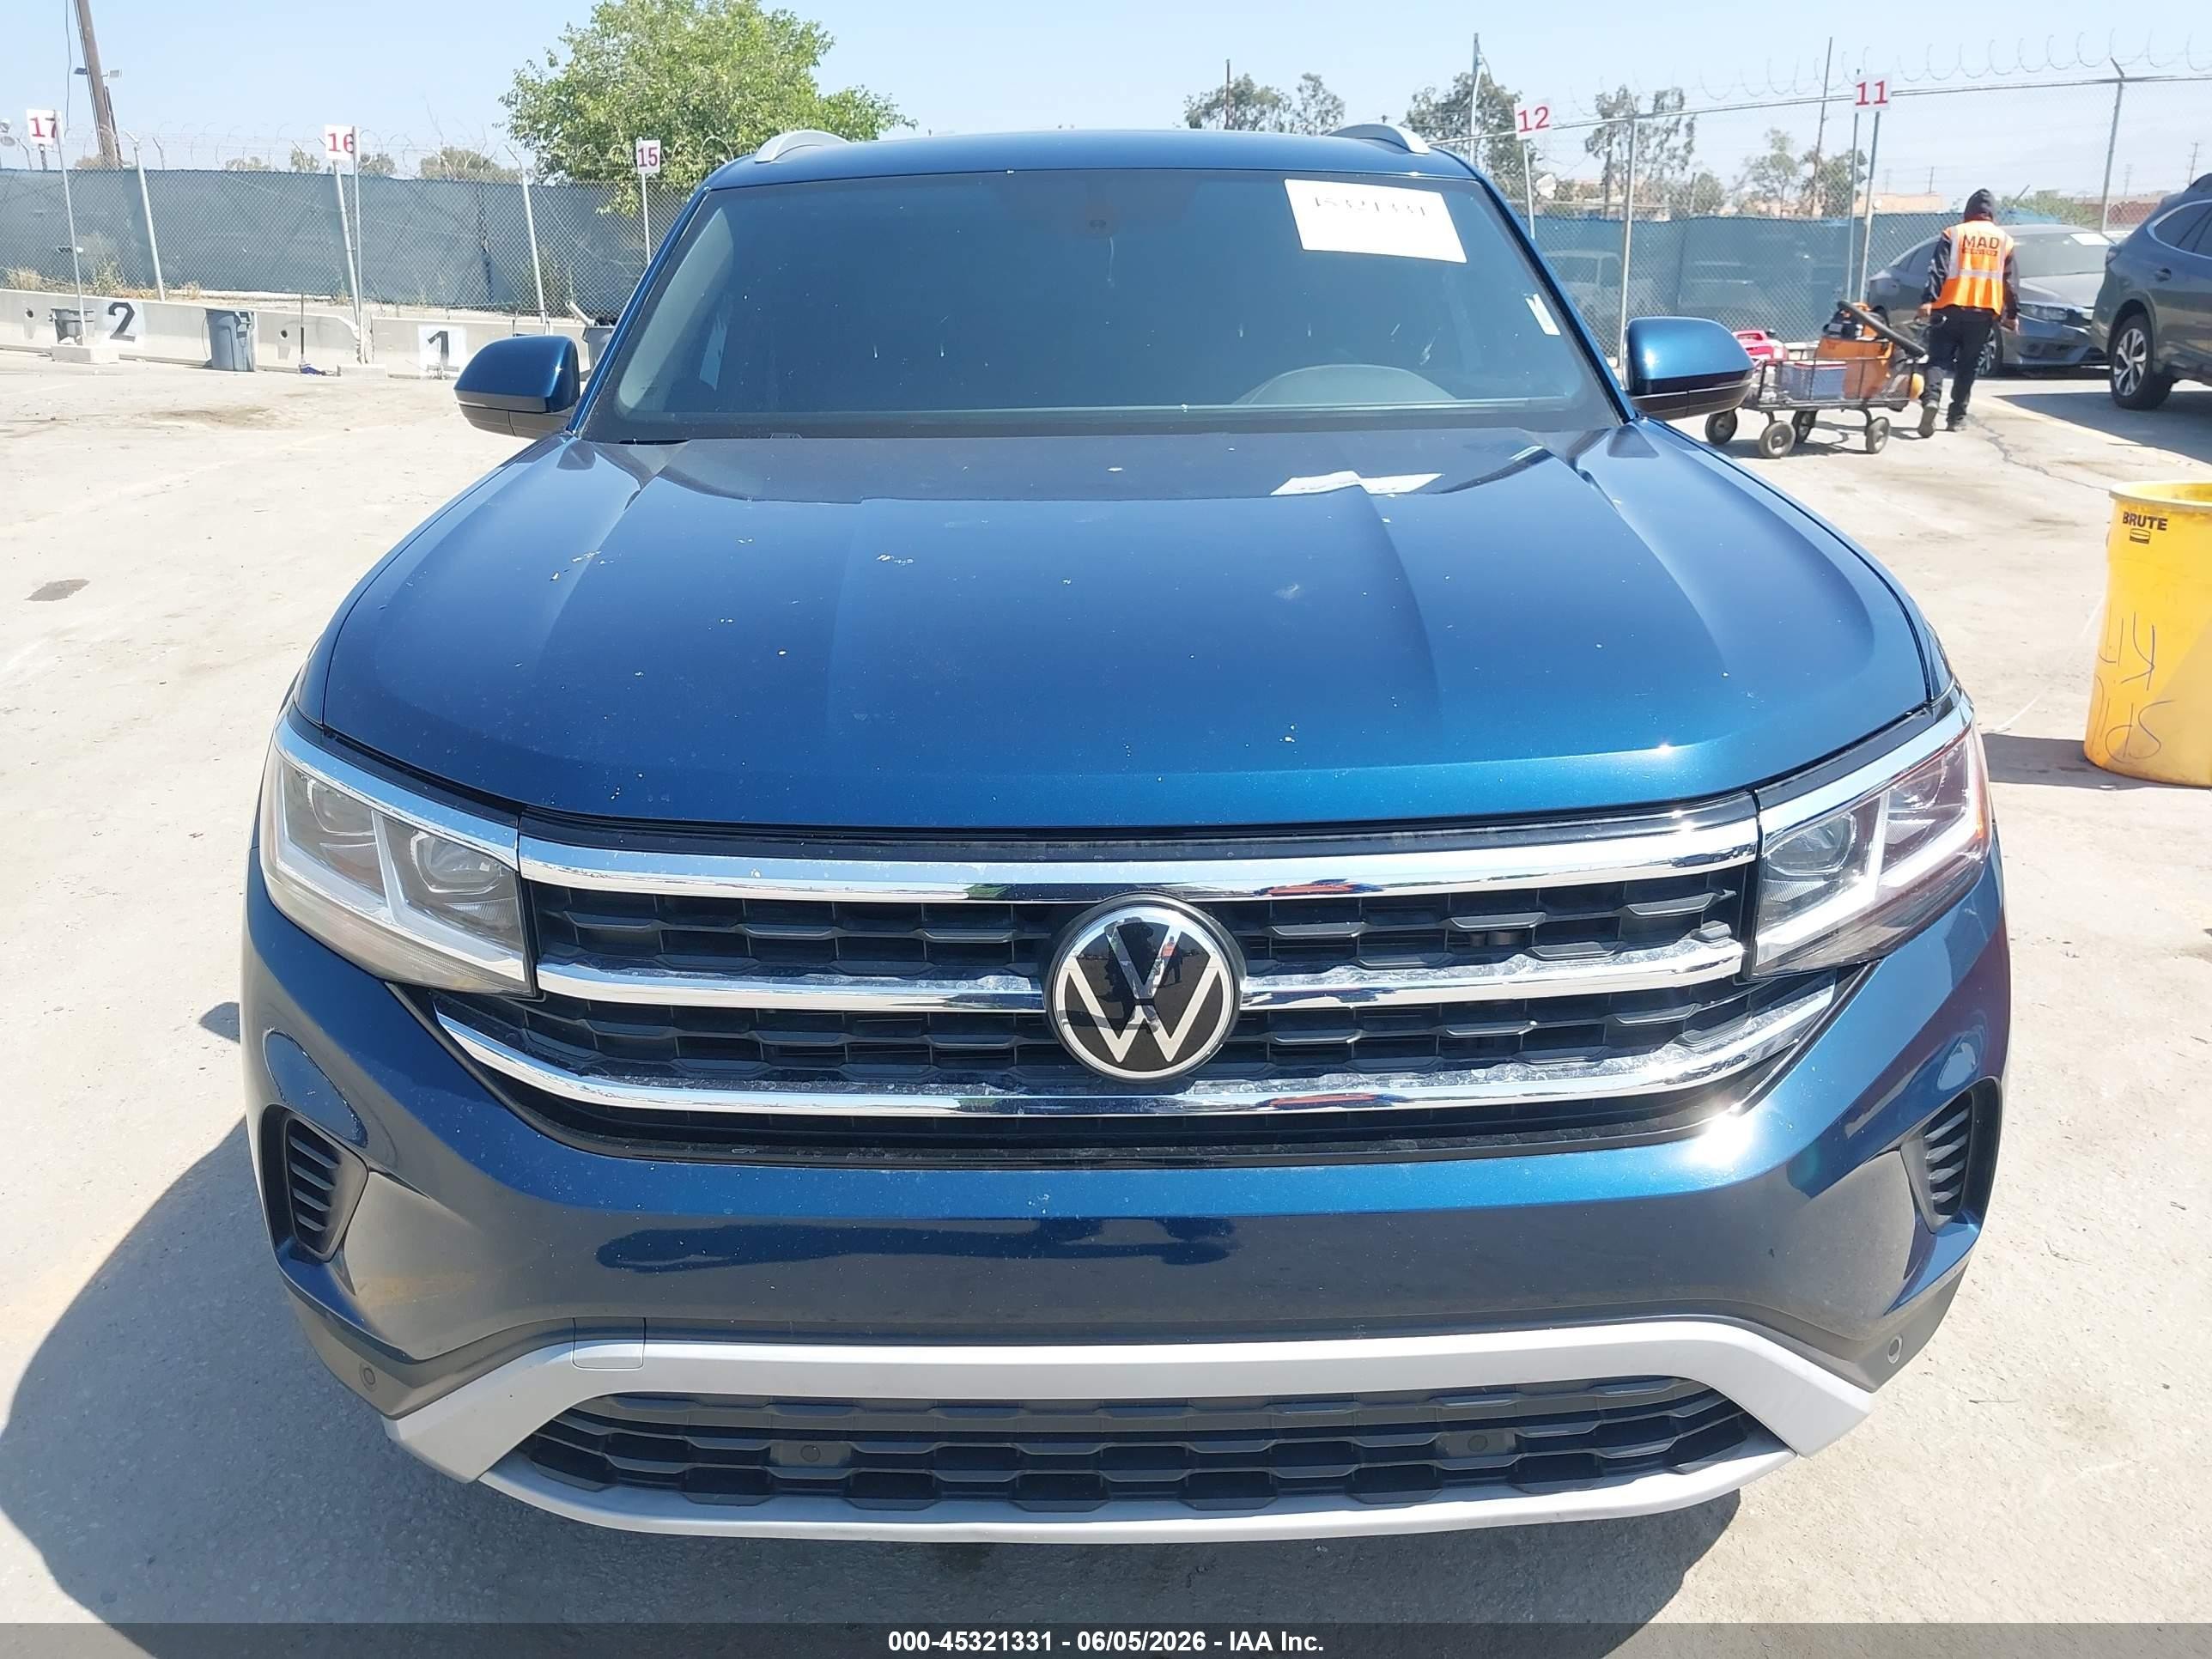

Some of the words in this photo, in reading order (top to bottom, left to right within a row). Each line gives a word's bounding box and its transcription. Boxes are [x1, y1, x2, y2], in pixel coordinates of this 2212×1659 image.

[1856, 80, 1889, 106] 11
[30, 117, 56, 138] 17
[1516, 106, 1550, 133] 12
[328, 133, 354, 154] 16
[637, 147, 658, 167] 15
[1962, 234, 2000, 249] MAD
[108, 302, 136, 343] 2
[428, 331, 460, 371] 1
[2123, 511, 2168, 531] BRUTE
